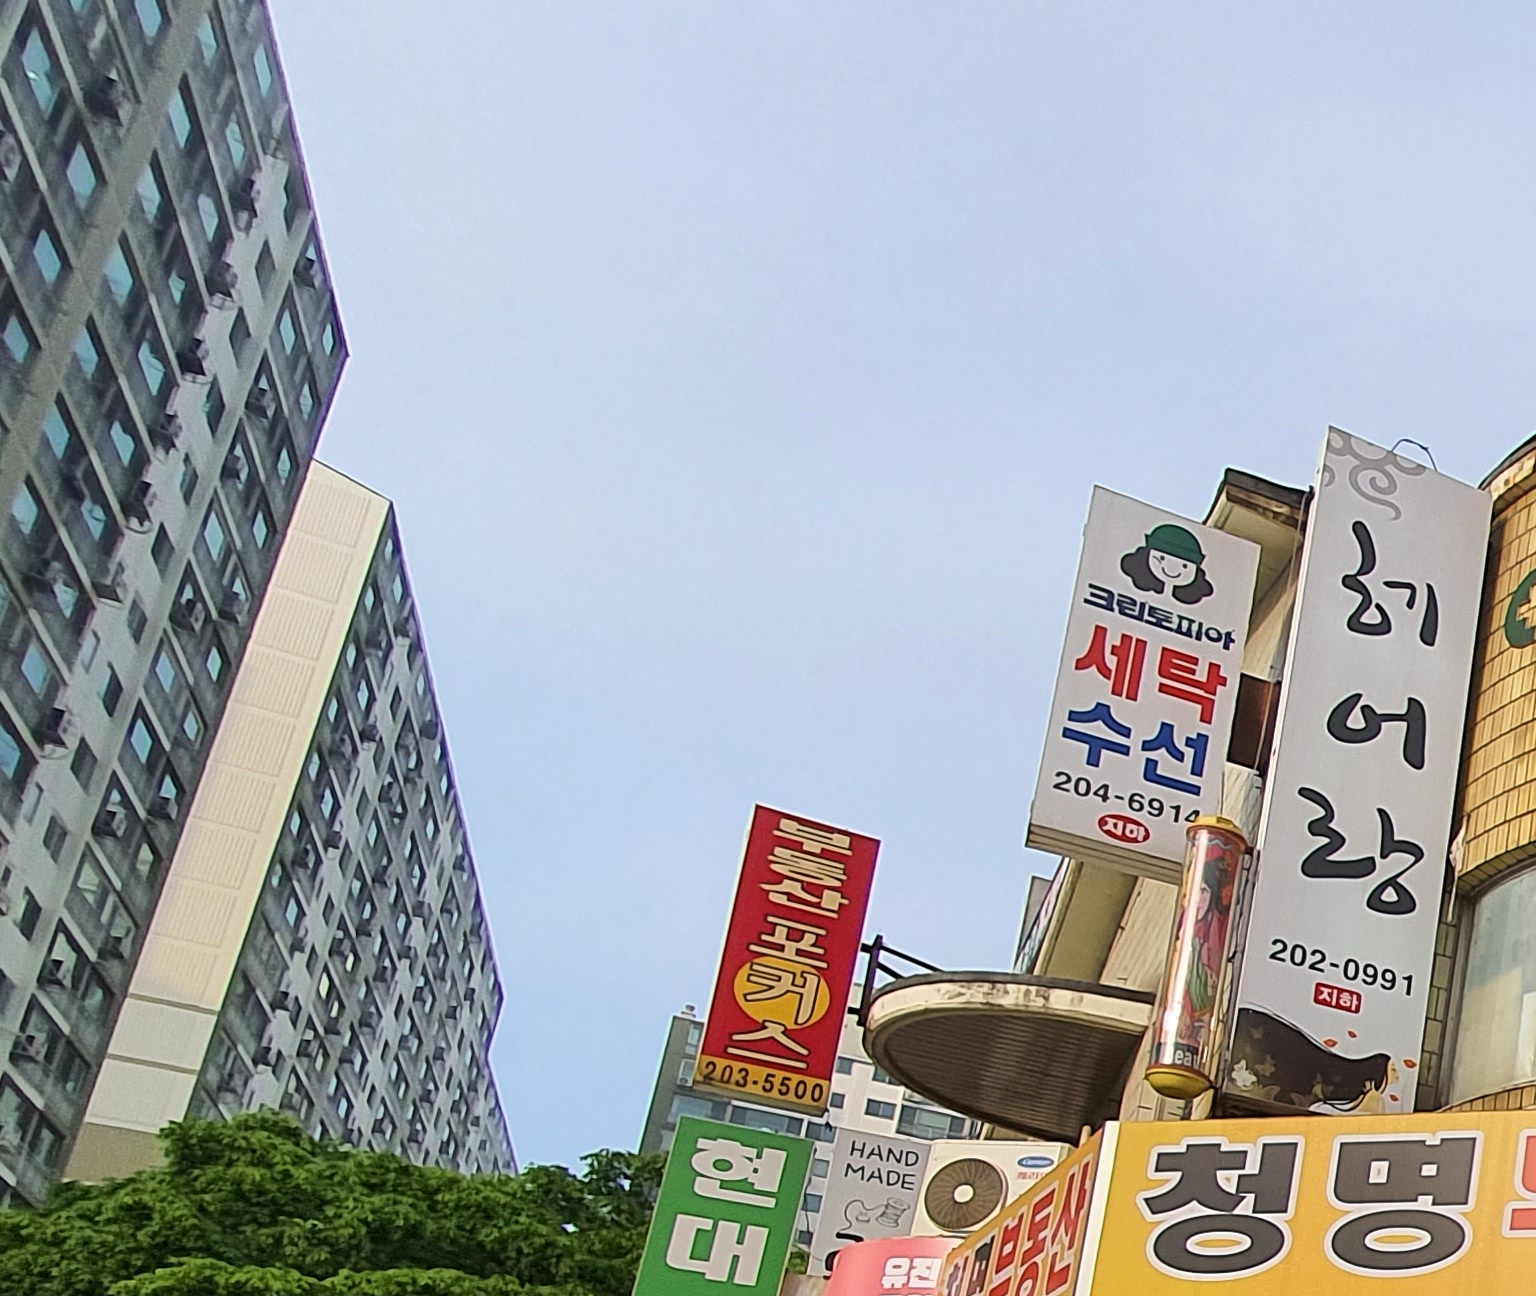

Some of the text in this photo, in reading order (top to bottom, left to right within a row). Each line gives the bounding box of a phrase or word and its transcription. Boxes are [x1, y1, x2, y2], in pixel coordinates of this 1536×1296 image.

[1084, 583, 1235, 651] 크린토피아
[1075, 623, 1227, 726] 세탁
[1298, 520, 1439, 915] 헤어랑
[1061, 701, 1208, 797] 수선
[1052, 770, 1201, 826] 204-6914
[1101, 816, 1148, 842] 지하
[727, 818, 852, 1069] 부동산 포커스
[1269, 938, 1416, 997] 202-0991
[1317, 986, 1360, 1011] 지하
[703, 1060, 824, 1103] 203-5500
[845, 1161, 916, 1192] MADE
[849, 1139, 920, 1168] HAND
[881, 1257, 942, 1289] 유진
